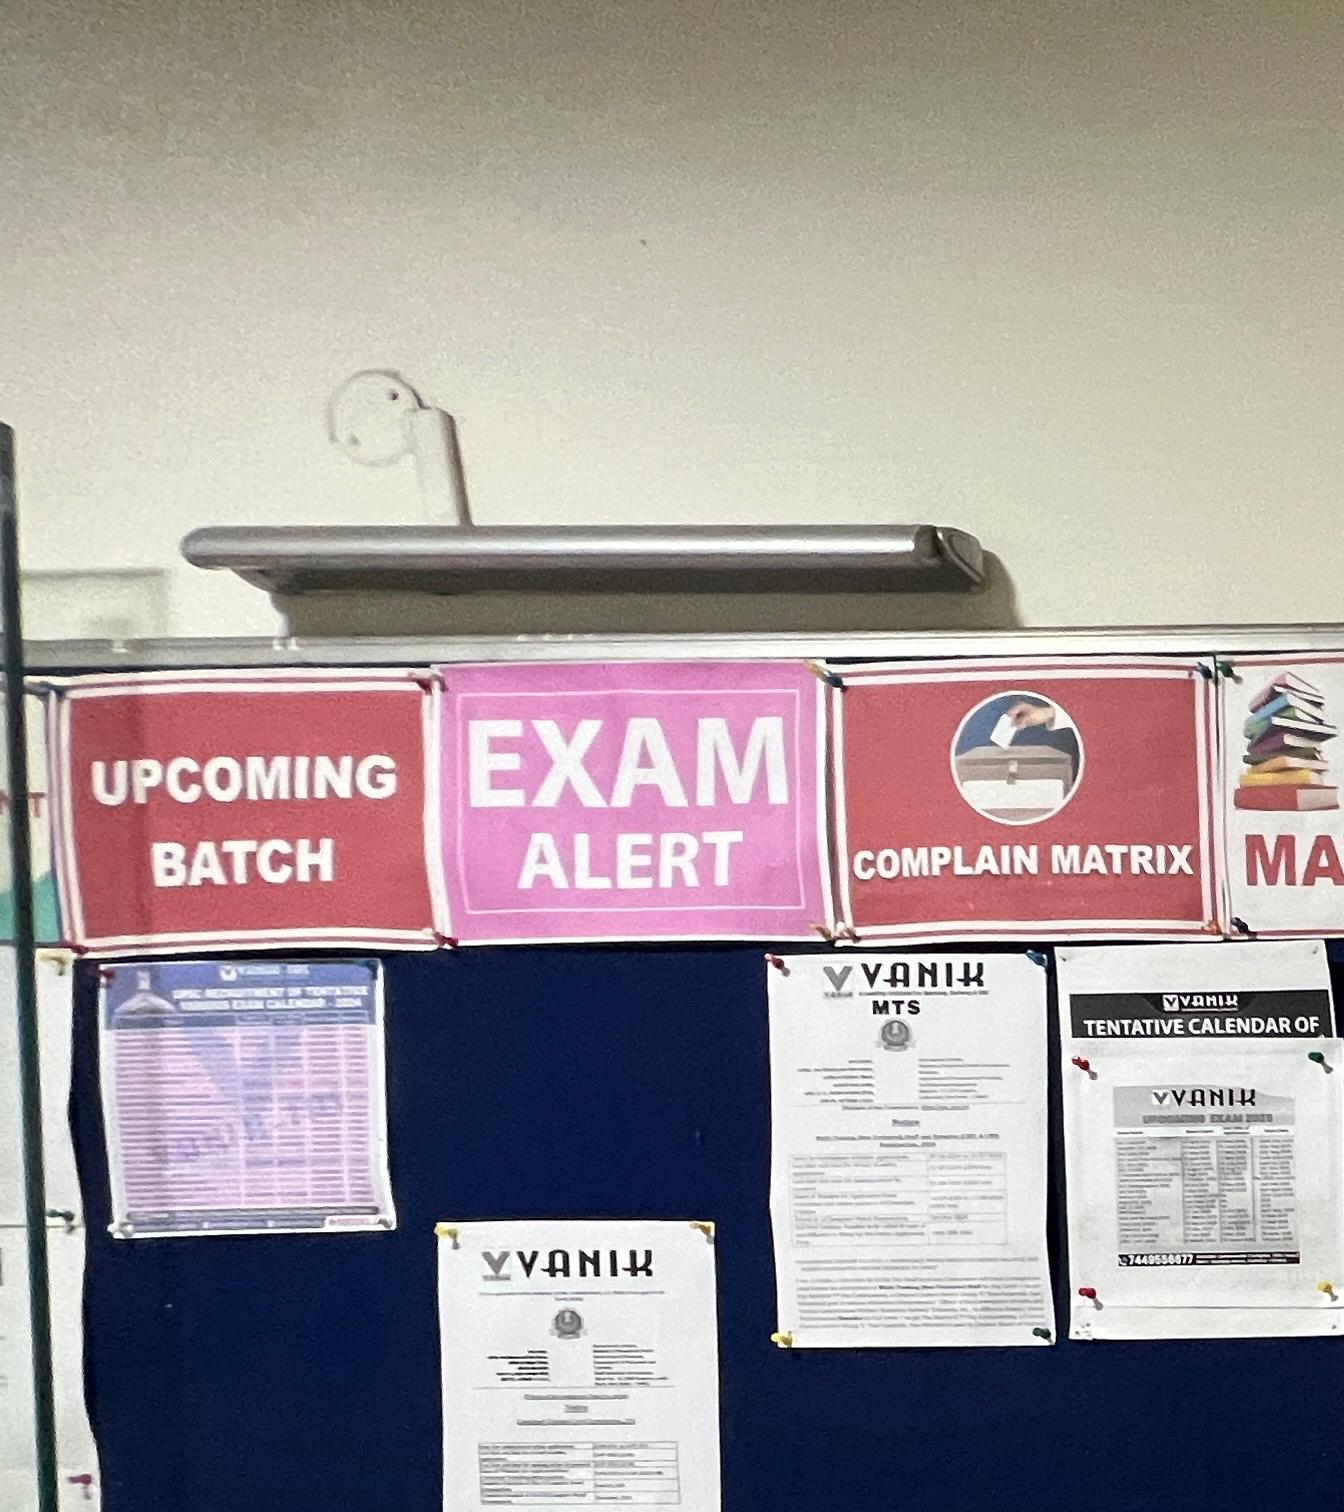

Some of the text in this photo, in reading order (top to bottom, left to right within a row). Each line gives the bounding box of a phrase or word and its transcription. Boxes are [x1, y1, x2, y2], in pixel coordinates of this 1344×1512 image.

[468, 716, 789, 808] EXAM
[91, 755, 398, 805] UPCOMING
[151, 838, 334, 887] BATCH
[517, 831, 743, 889] ALERT
[853, 843, 1193, 880] COMPLAIN MATRIX
[861, 962, 984, 987] VANIK
[872, 1000, 921, 1014] MTS
[1180, 995, 1238, 1008] VANIK
[1084, 1016, 1319, 1037] TENTATIVE CALENDAR OF
[1171, 1088, 1256, 1107] VANIK
[517, 1249, 653, 1278] VANIK
